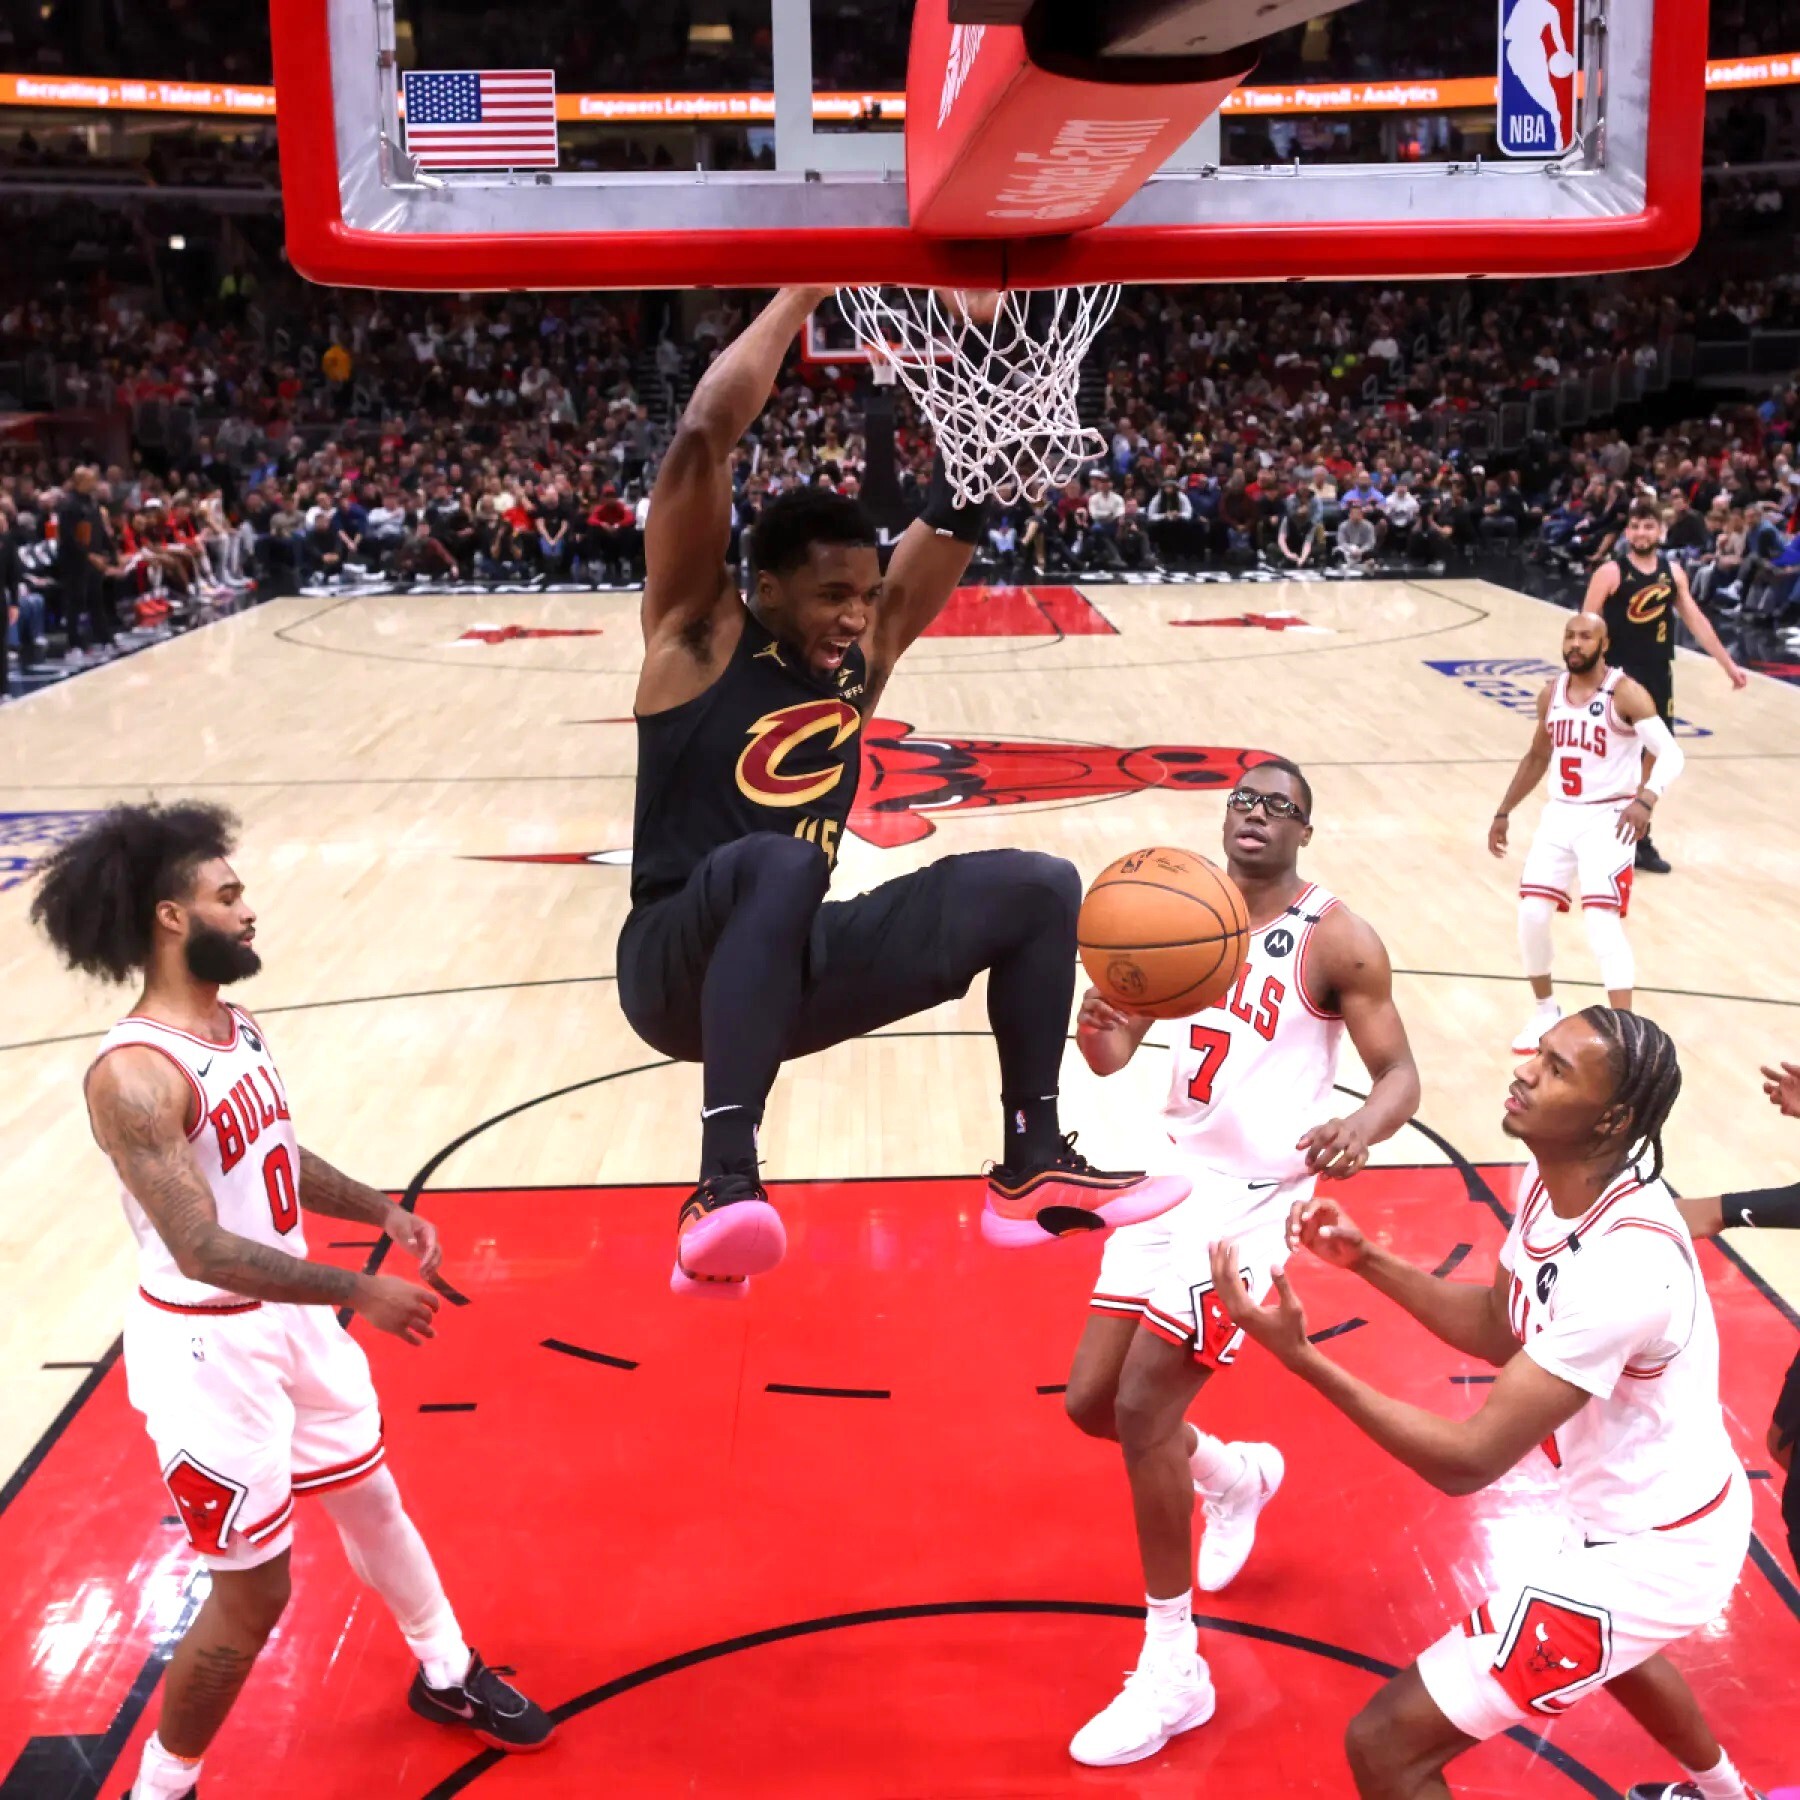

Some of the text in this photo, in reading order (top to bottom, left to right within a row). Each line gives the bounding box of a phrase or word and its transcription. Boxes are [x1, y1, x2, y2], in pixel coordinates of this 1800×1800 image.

[1705, 63, 1768, 84] Leaders
[1771, 61, 1789, 77] to
[16, 78, 266, 107] Recruiting HR Talent Time
[580, 97, 662, 117] Empowers
[665, 98, 726, 114] Leaders
[729, 99, 747, 113] to
[1244, 90, 1284, 107] Time
[1295, 88, 1351, 108] Payroll
[1361, 86, 1438, 105] Analytics
[1509, 114, 1546, 143] NBA
[1656, 621, 1667, 643] 2
[1560, 756, 1582, 797] 5
[1188, 1024, 1231, 1105] 7
[210, 1065, 291, 1176] BULL
[262, 1143, 298, 1236] 0
